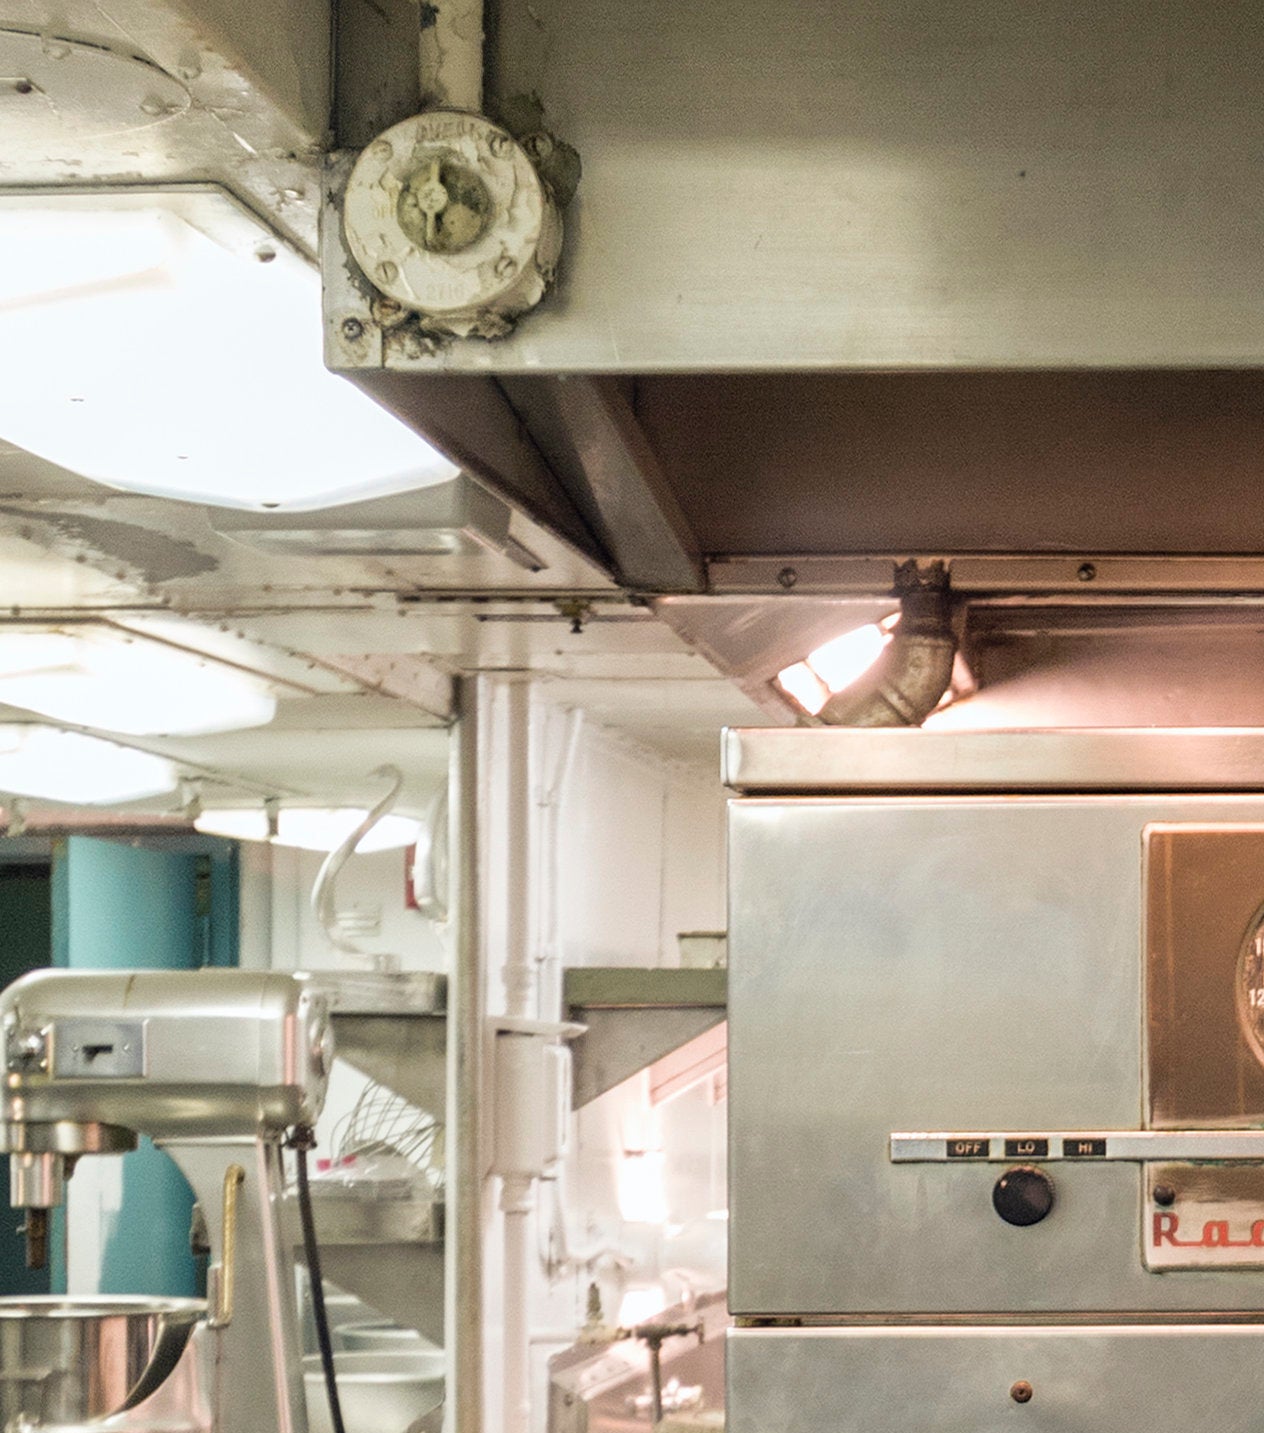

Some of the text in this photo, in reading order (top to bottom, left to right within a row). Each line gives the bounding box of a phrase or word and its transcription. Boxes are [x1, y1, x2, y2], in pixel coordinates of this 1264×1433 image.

[955, 1143, 981, 1154] OFF
[1017, 1142, 1036, 1154] LO
[1078, 1143, 1093, 1154] HI
